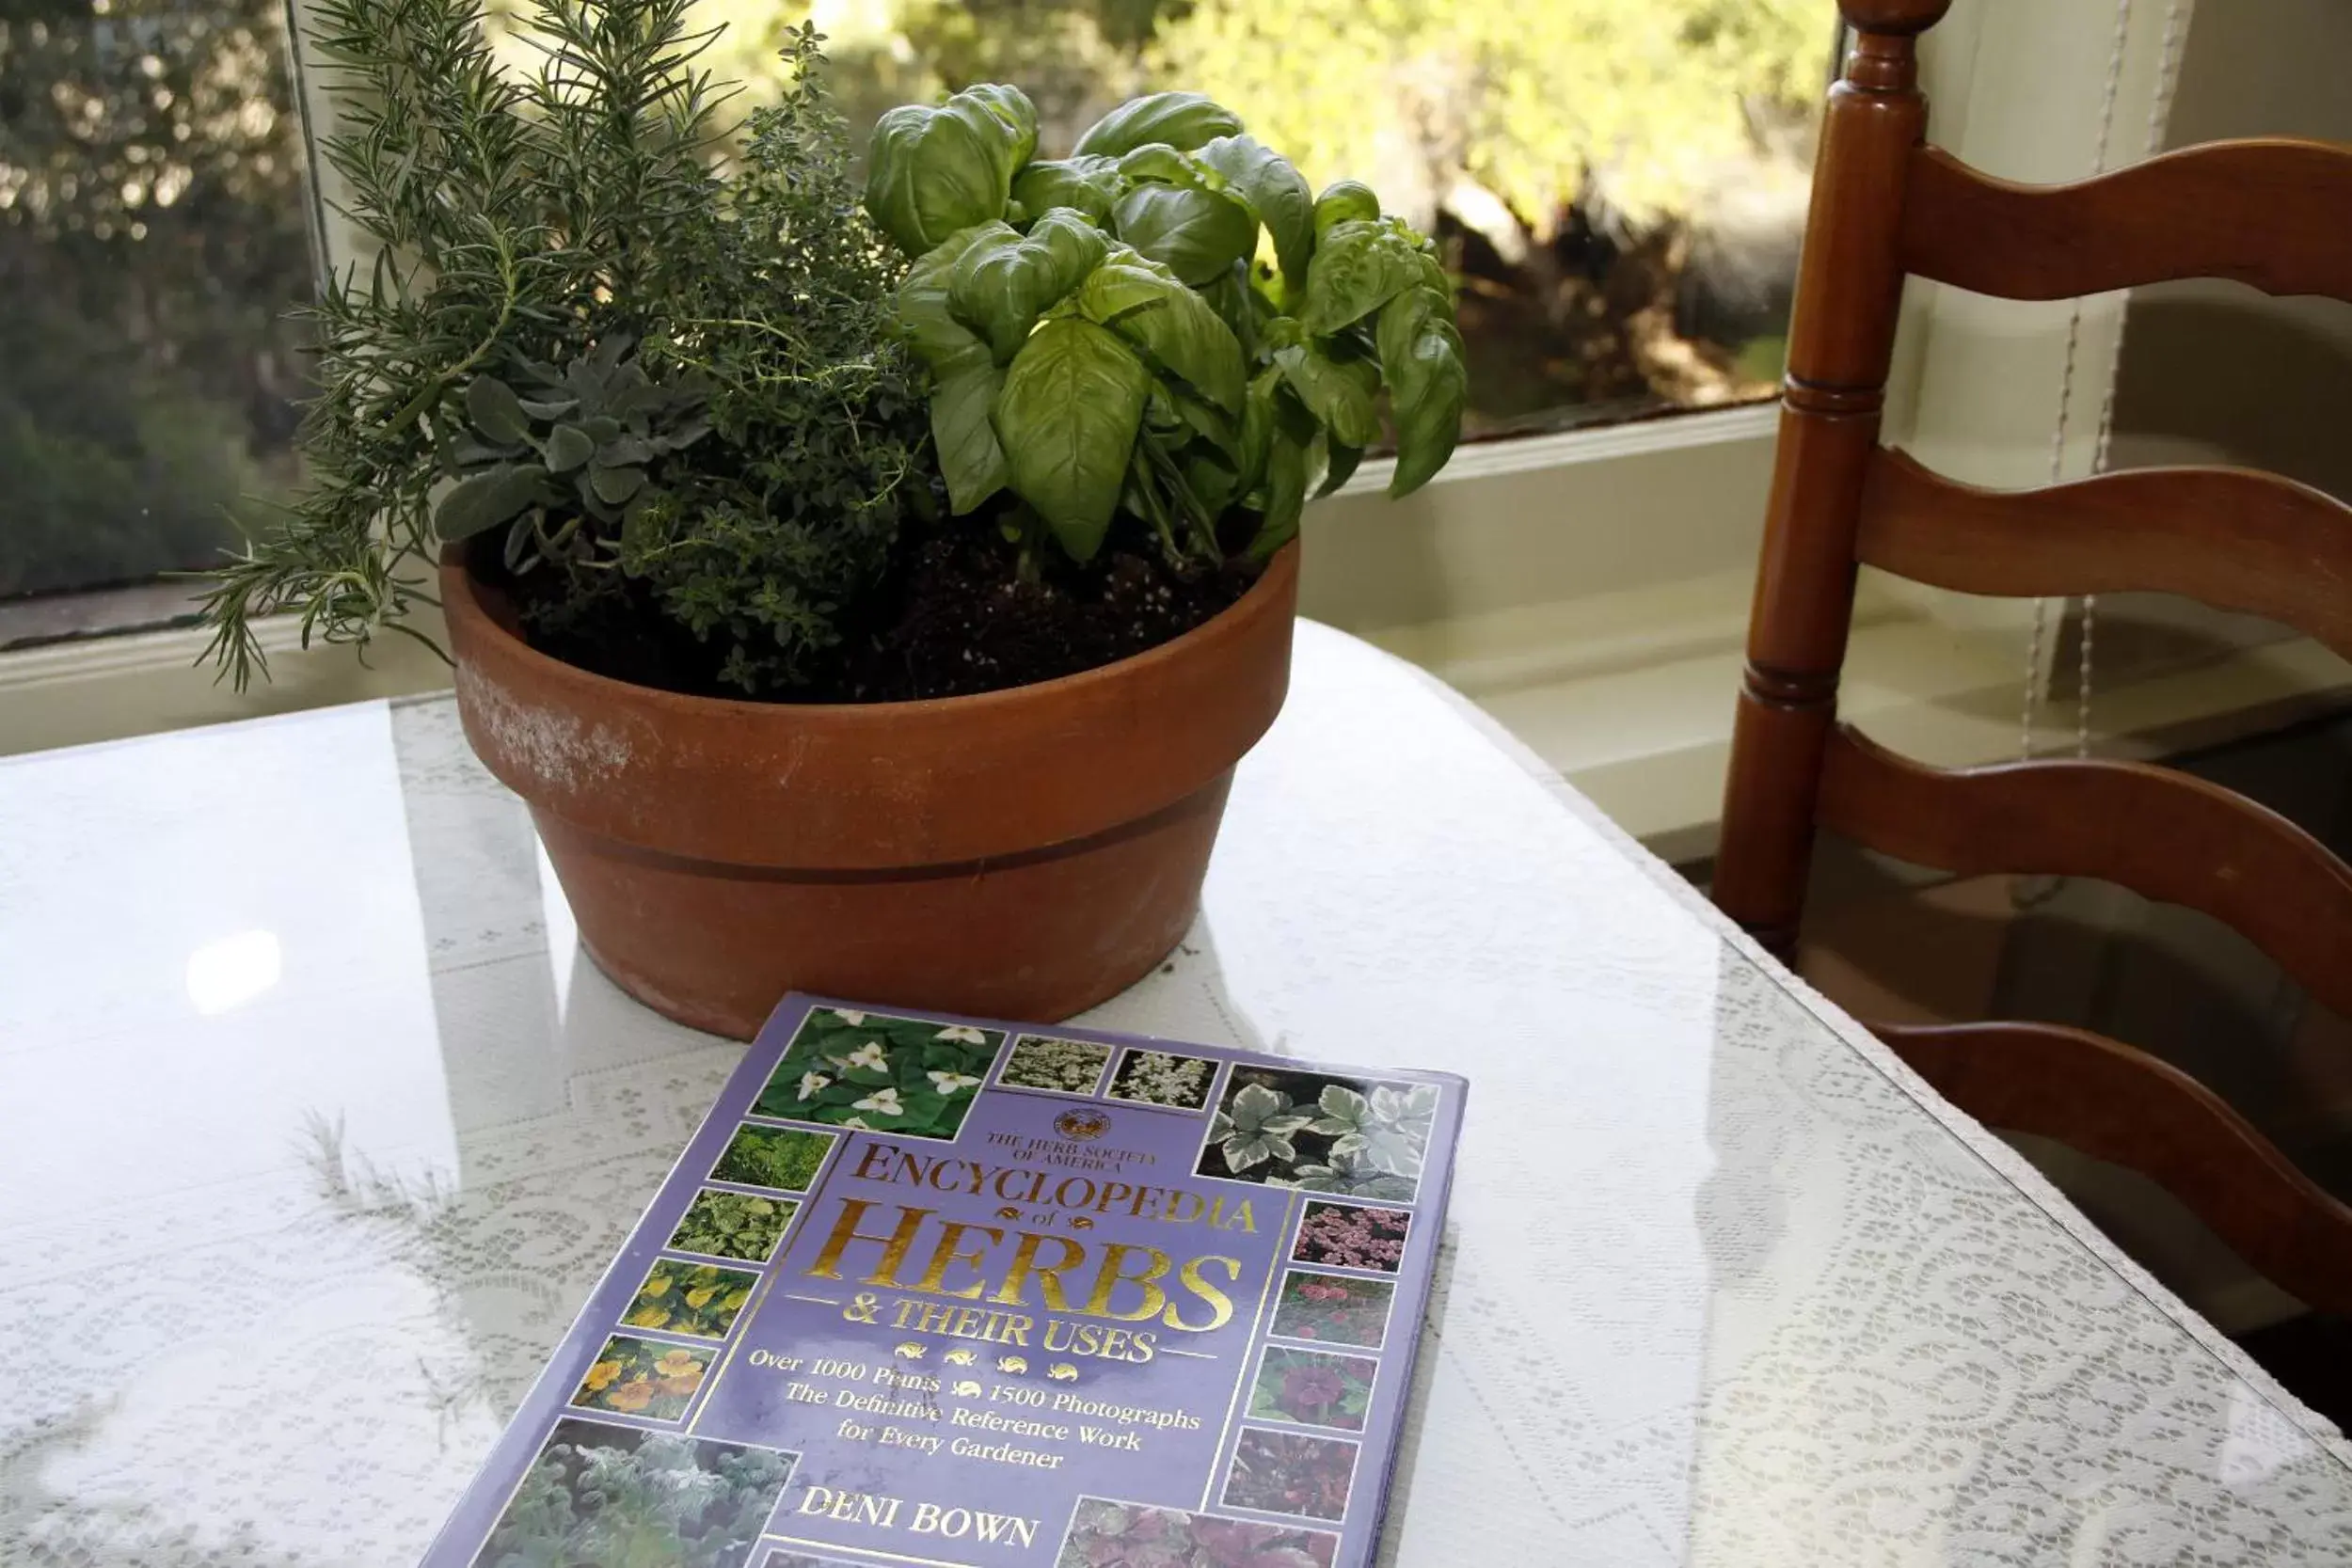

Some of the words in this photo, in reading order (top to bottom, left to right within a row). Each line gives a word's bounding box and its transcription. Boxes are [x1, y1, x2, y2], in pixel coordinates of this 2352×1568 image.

[850, 1142, 1257, 1233] ENCYCLOPEDIA
[1031, 1212, 1056, 1228] of
[803, 1196, 1242, 1333] HERBS
[841, 1291, 880, 1325] &
[888, 1300, 1034, 1351] THEIR
[1042, 1319, 1158, 1364] USES
[749, 1349, 803, 1373] Over
[811, 1357, 866, 1383] 1000
[989, 1383, 1046, 1409] 1500
[1054, 1393, 1203, 1433] Photographs
[787, 1381, 829, 1408] The
[834, 1390, 944, 1423] Definitive
[950, 1407, 1070, 1442] Reference
[1078, 1424, 1143, 1453] Work
[837, 1418, 874, 1441] for
[881, 1425, 945, 1457] Every
[950, 1437, 1064, 1470] Gardener
[799, 1485, 902, 1528] DENI
[911, 1502, 1041, 1550] BOWN
